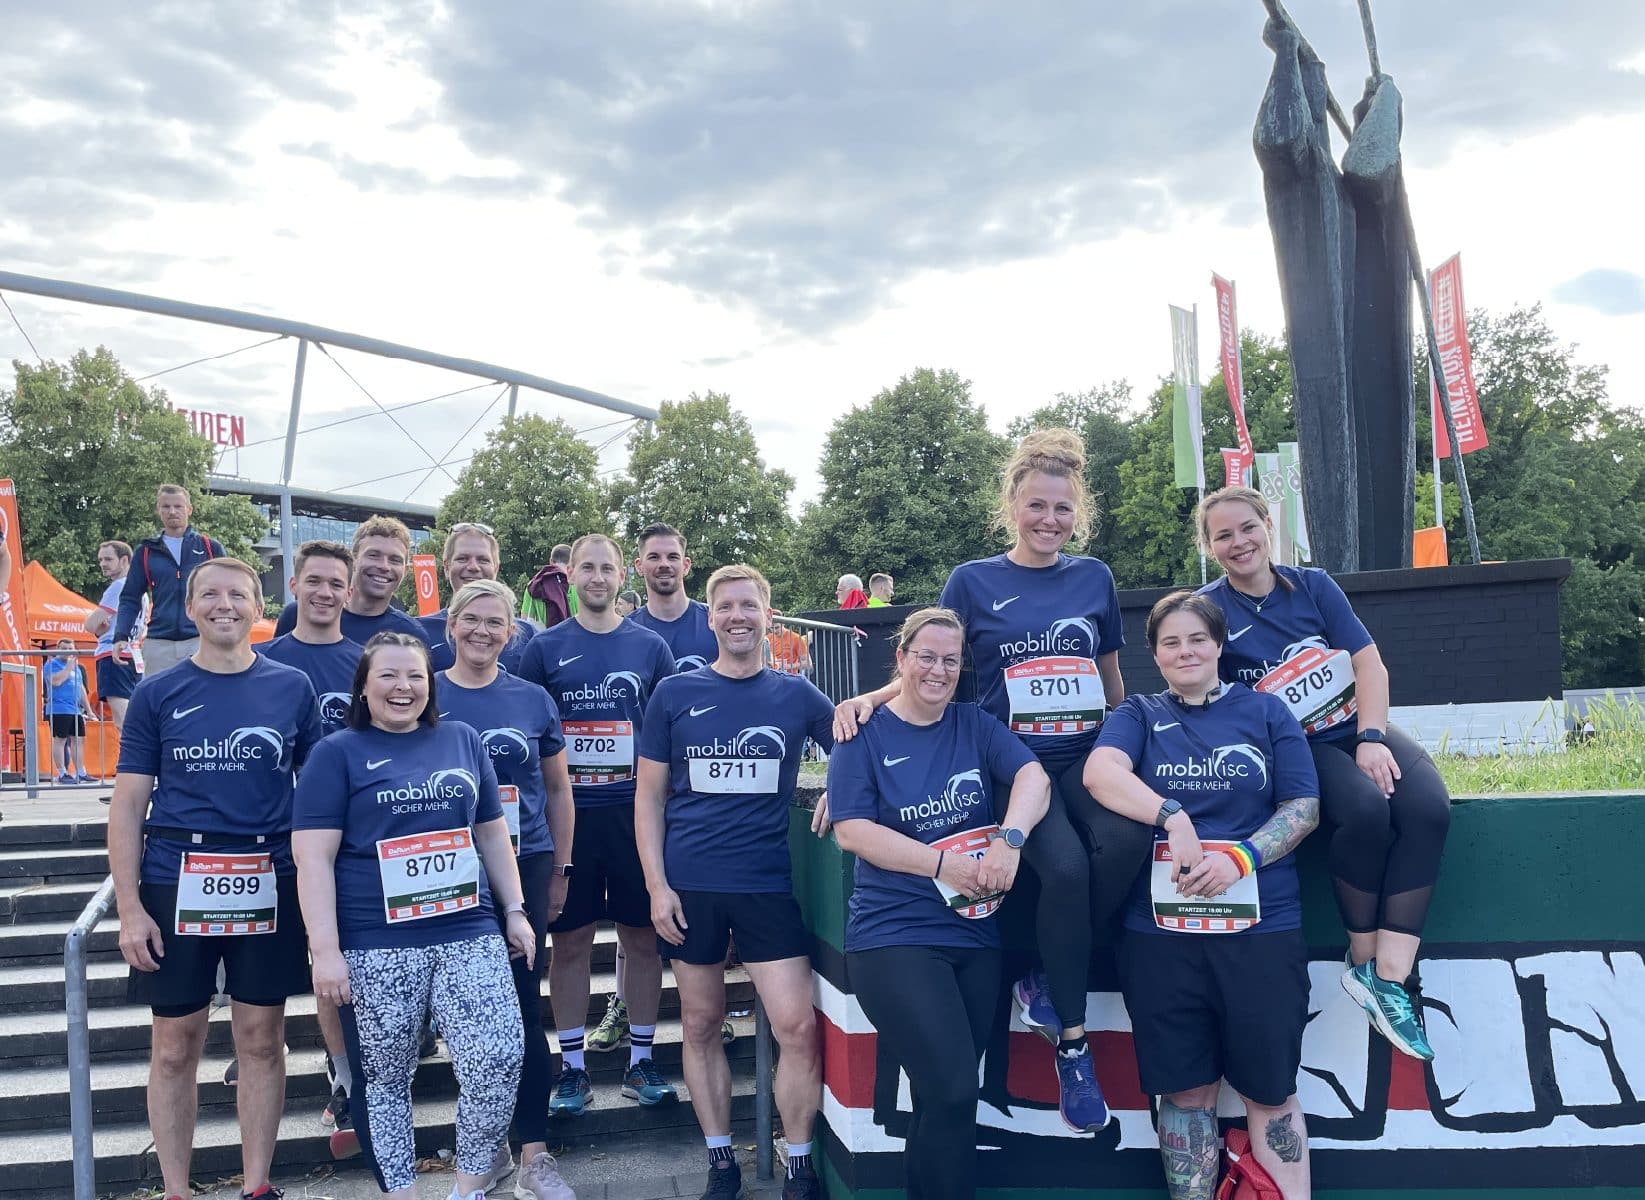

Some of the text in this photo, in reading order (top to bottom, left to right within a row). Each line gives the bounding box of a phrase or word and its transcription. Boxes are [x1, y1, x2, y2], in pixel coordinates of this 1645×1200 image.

[34, 620, 86, 633] LAST MINU
[1029, 677, 1081, 697] 8701
[1284, 664, 1334, 704] 8705
[571, 702, 596, 711] SICHER
[574, 738, 616, 753] 8702
[185, 762, 216, 772] SICHER
[708, 762, 757, 779] 8711
[1167, 780, 1201, 791] SICHER
[391, 803, 423, 815] SICHER
[915, 818, 946, 833] SICHER
[406, 852, 457, 877] 8707
[202, 876, 260, 896] 8699
